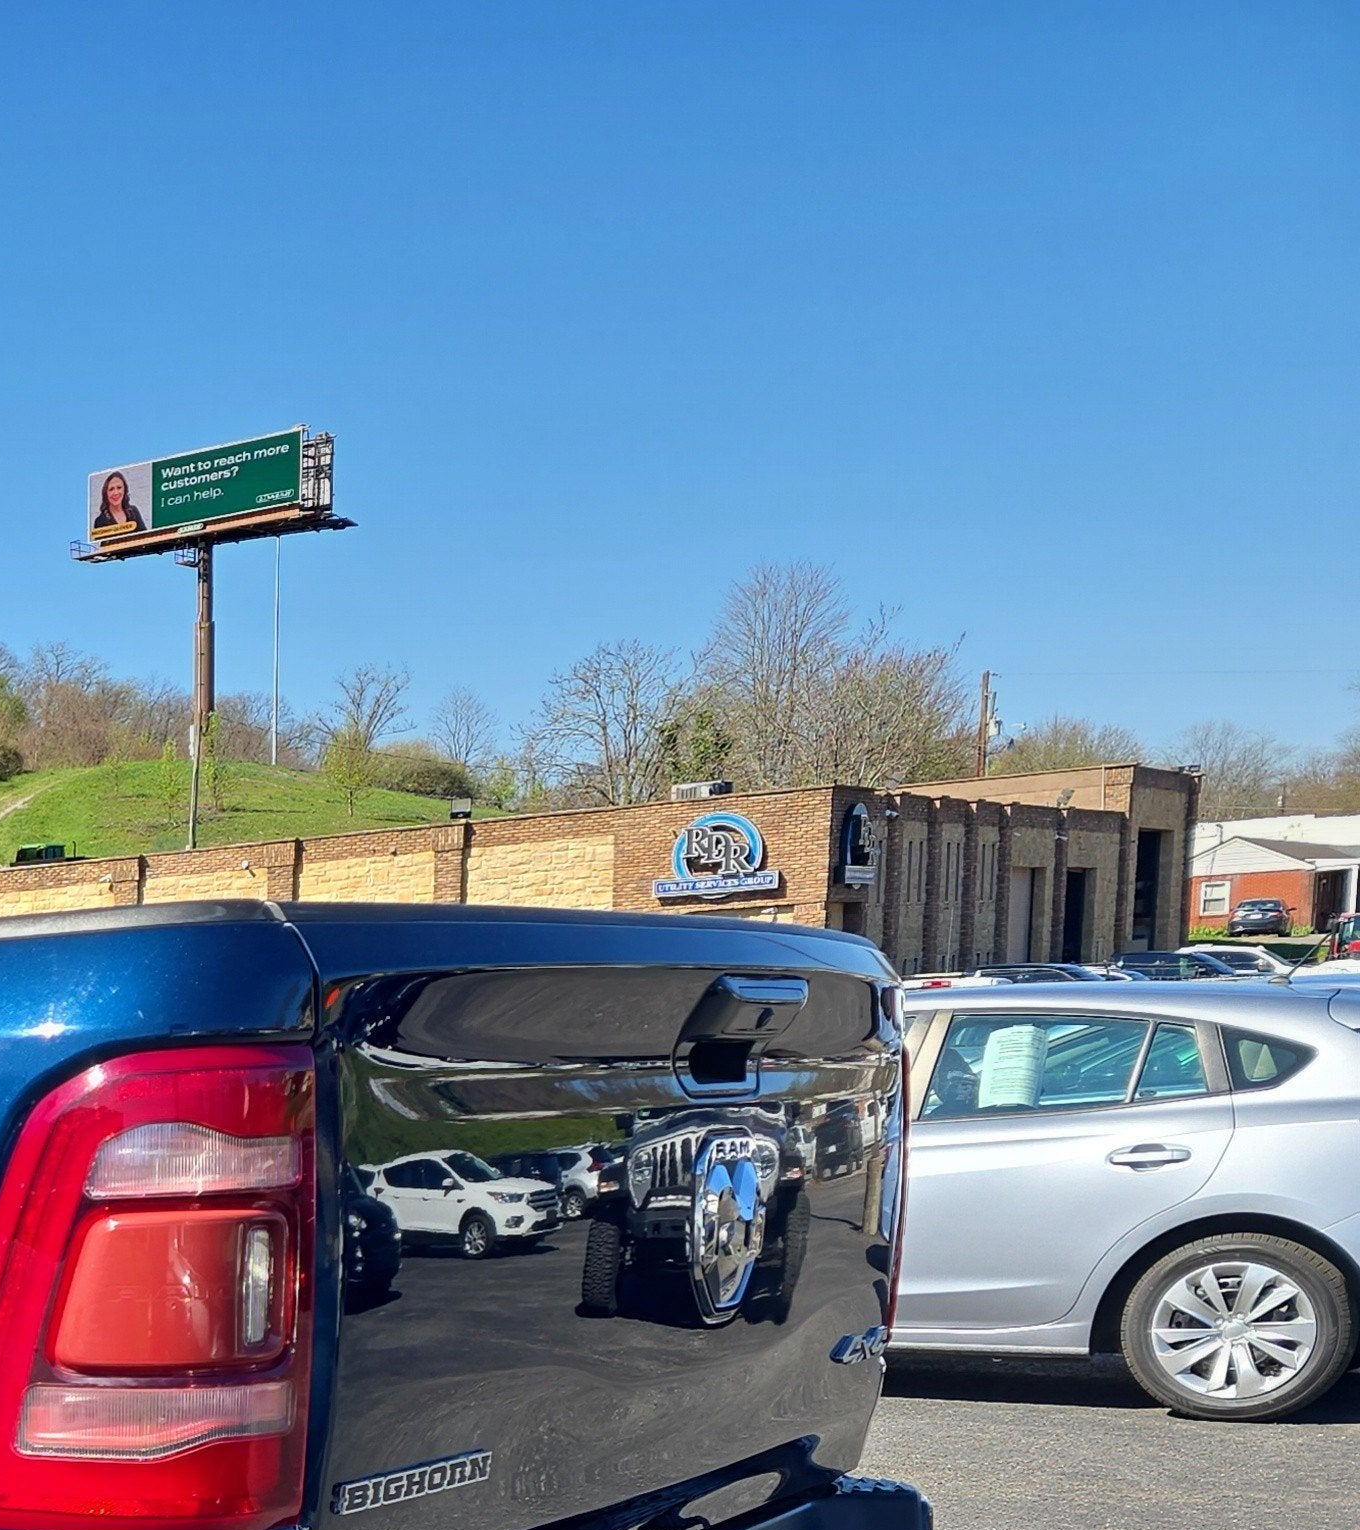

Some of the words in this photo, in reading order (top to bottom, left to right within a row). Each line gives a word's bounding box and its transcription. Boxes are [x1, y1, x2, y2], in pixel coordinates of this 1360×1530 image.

[161, 463, 195, 478] Want
[198, 461, 211, 471] to
[214, 451, 251, 467] reach
[254, 444, 290, 459] more
[161, 466, 239, 491] customers?
[167, 494, 191, 506] can
[194, 487, 224, 500] help.
[682, 826, 755, 875] RDR
[658, 882, 694, 892] UTILITY
[695, 878, 739, 889] SERVICES
[741, 876, 773, 886] GROUP
[716, 1140, 750, 1156] RAM
[336, 1451, 492, 1515] BIGHORN
